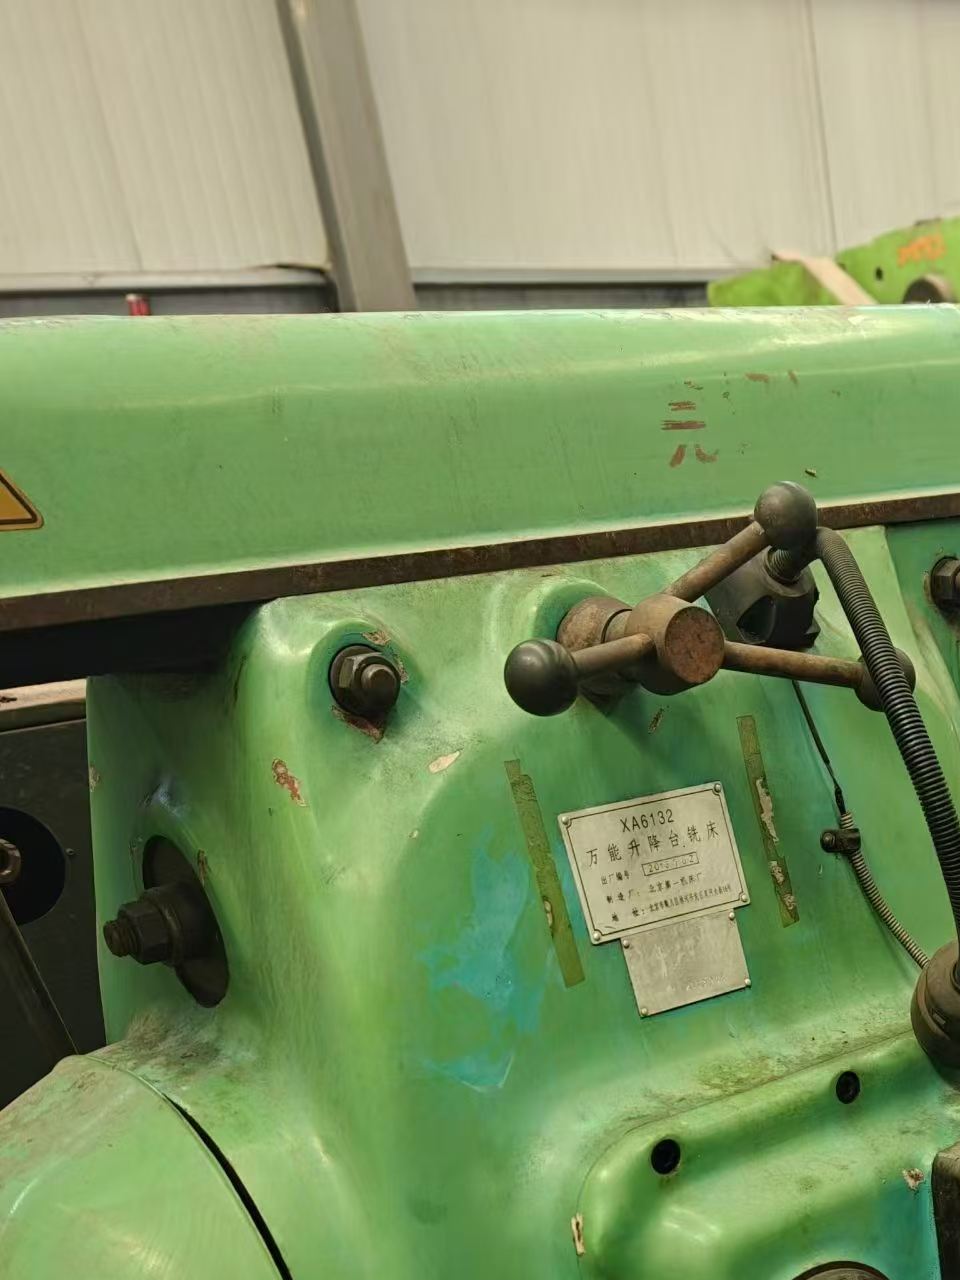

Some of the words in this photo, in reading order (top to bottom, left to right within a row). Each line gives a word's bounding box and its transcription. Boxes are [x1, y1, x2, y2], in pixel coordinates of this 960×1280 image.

[620, 808, 674, 832] XA6132
[586, 820, 720, 867] 万能升降台铣床
